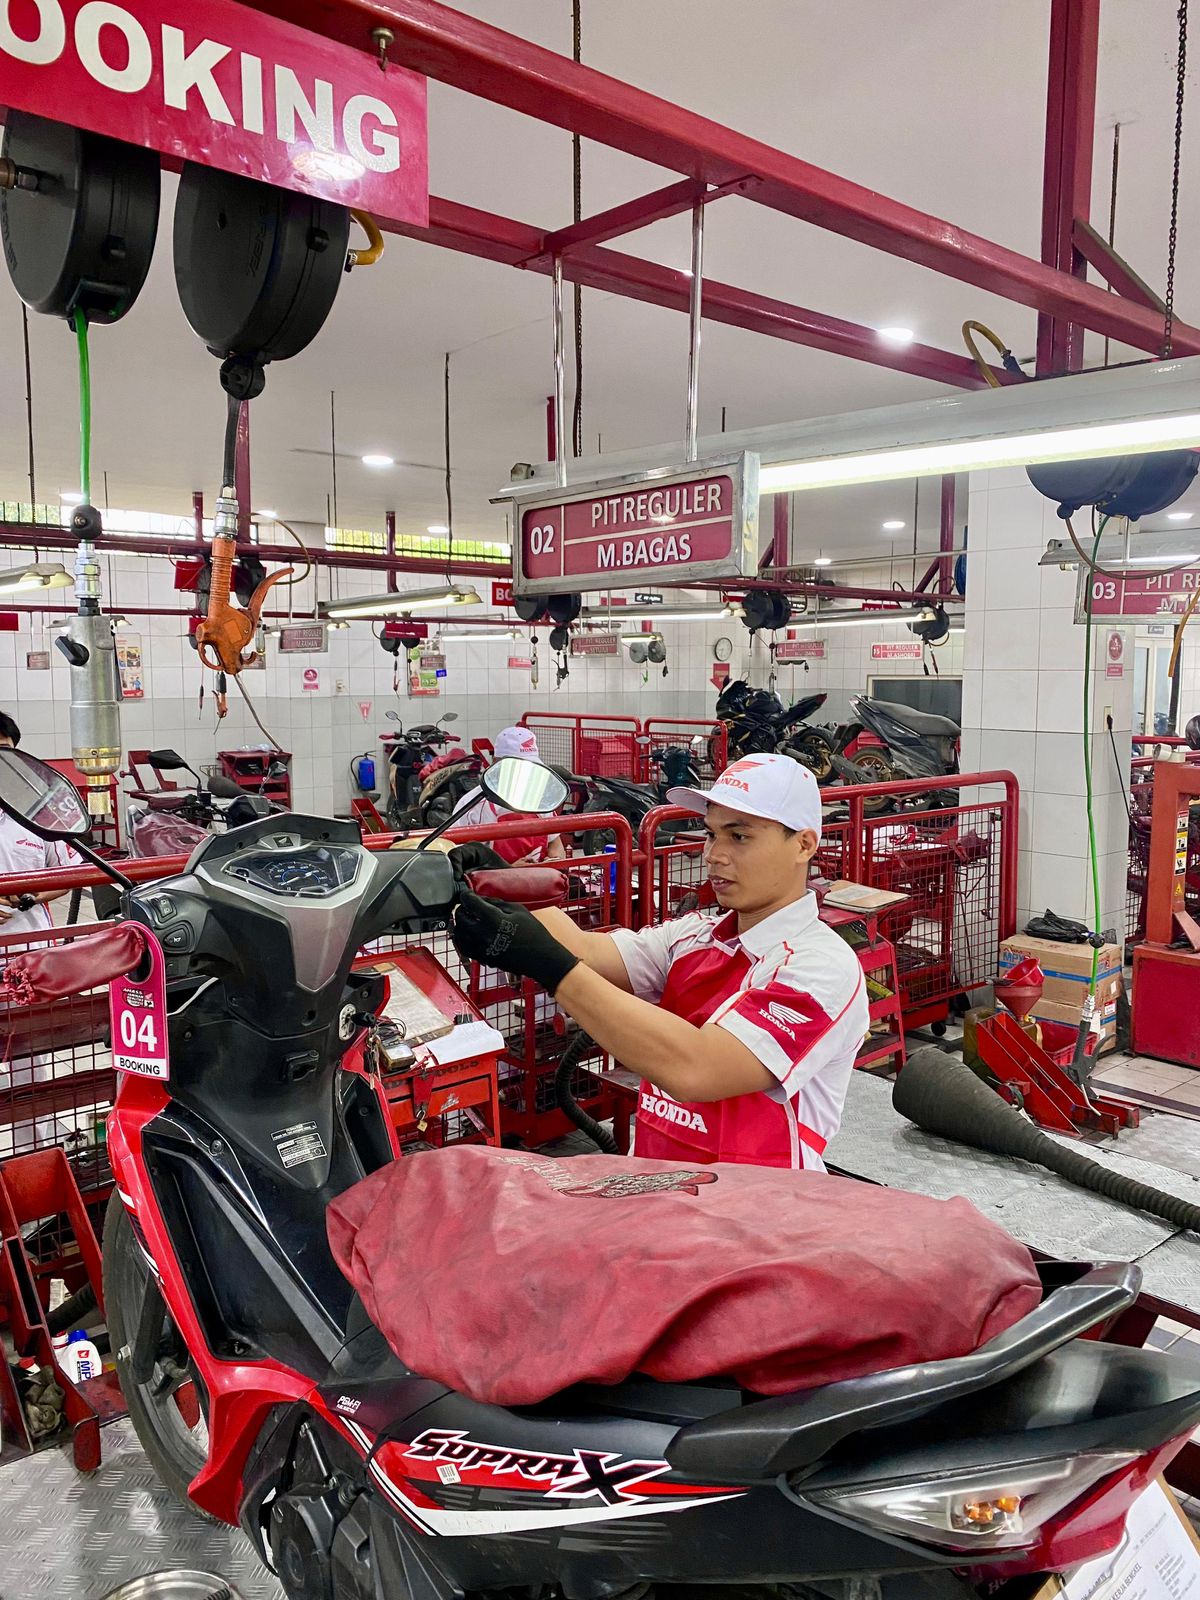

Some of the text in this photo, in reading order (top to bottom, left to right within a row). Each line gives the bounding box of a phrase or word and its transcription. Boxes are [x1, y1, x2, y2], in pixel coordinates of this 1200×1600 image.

[530, 524, 555, 555] 02
[597, 533, 692, 568] M.BAGAS
[1092, 582, 1116, 600] 03
[1146, 573, 1175, 590] PIT
[120, 1009, 158, 1053] 04
[757, 1008, 796, 1041] HONDA
[119, 1057, 161, 1075] BOOKING
[640, 1092, 708, 1134] HONDA
